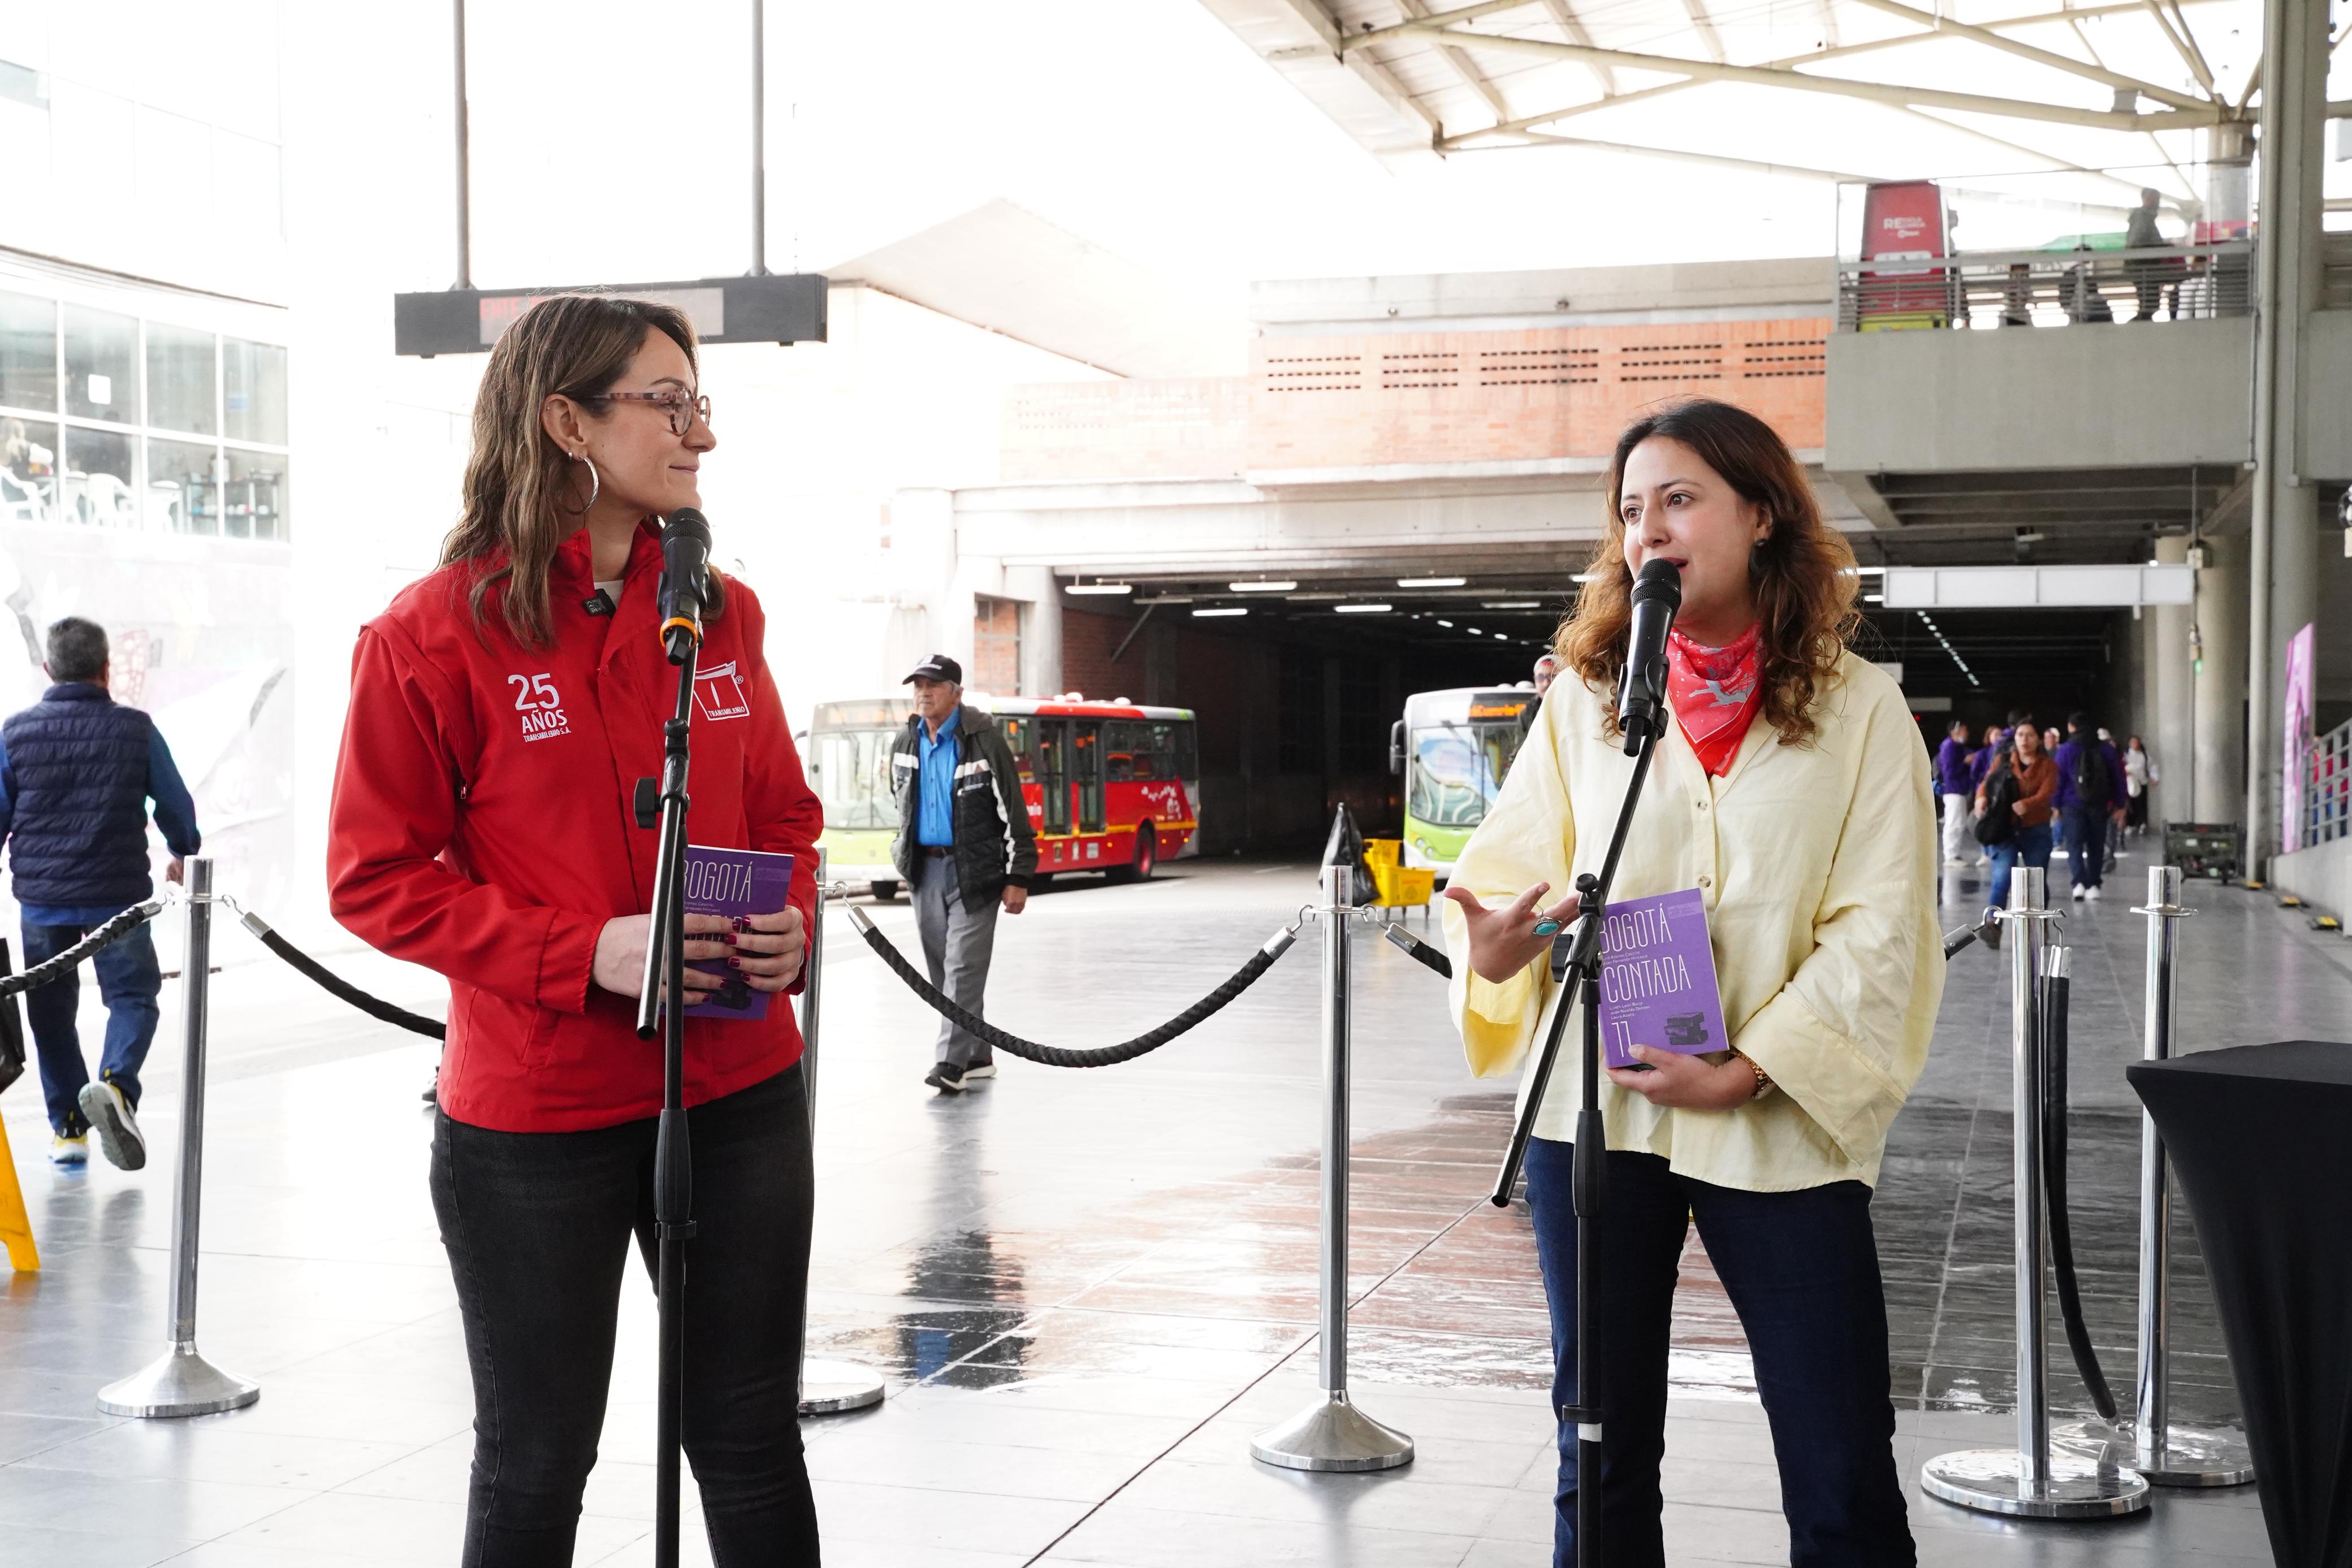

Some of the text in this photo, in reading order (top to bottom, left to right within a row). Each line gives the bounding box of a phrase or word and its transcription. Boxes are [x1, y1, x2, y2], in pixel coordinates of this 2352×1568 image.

[508, 673, 560, 711] 25
[522, 709, 568, 734] AÑOS
[708, 706, 745, 717] TRANSMILENIO
[523, 729, 560, 742] TRANSMILENIO
[1604, 954, 1691, 1003] CONTADA
